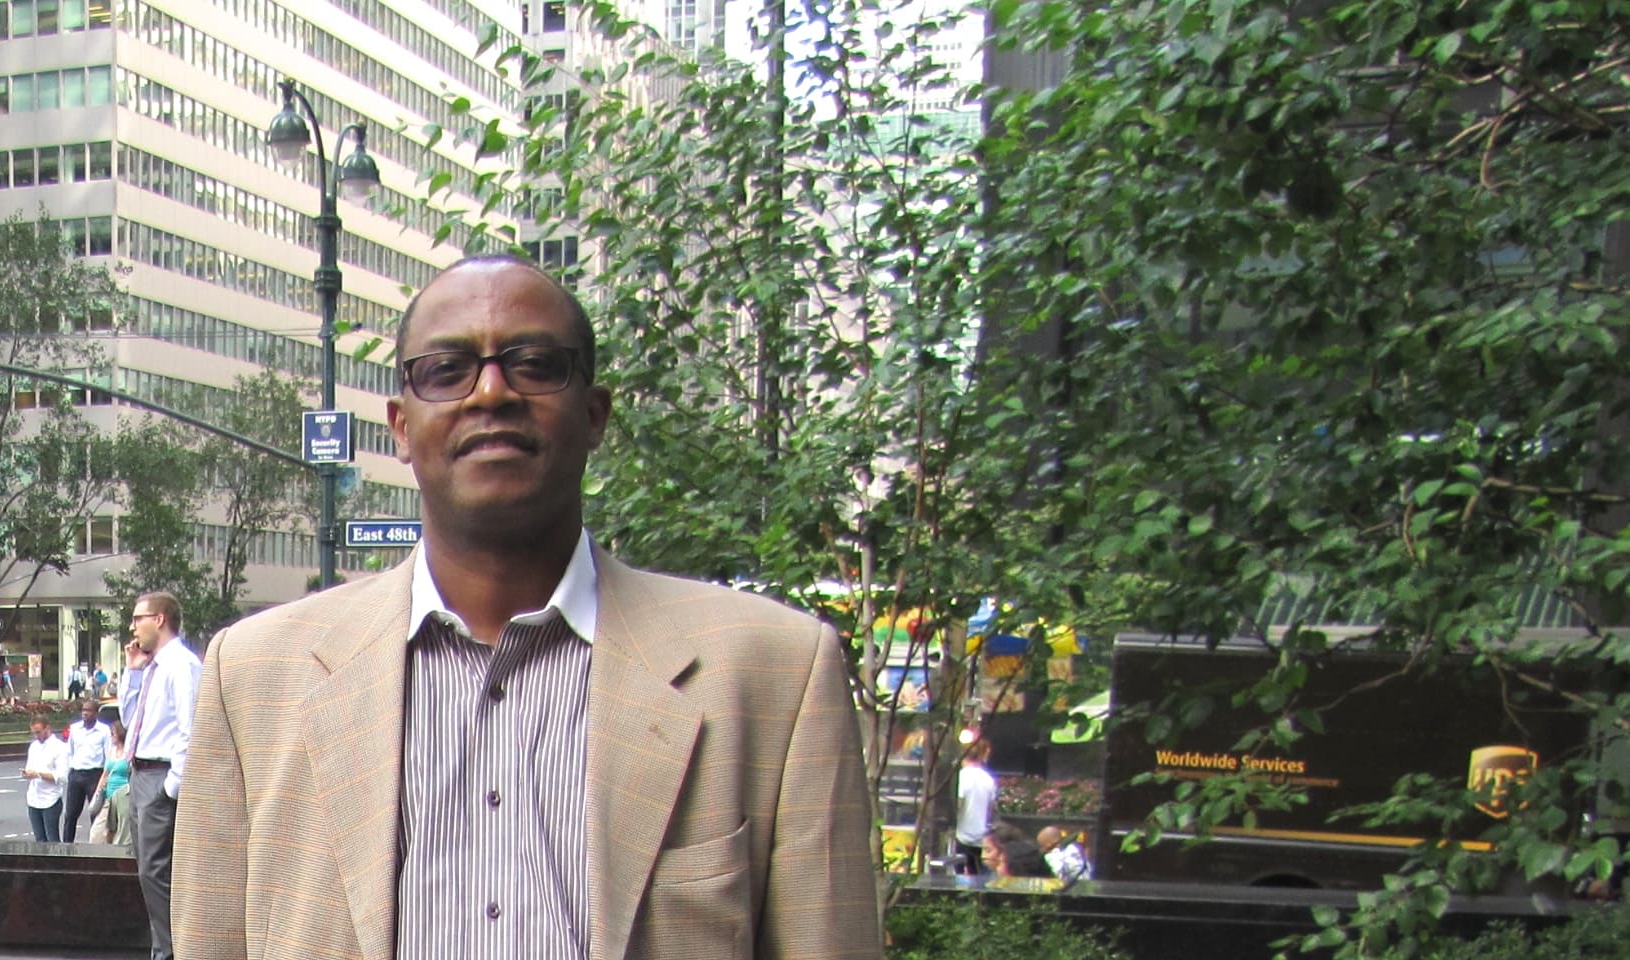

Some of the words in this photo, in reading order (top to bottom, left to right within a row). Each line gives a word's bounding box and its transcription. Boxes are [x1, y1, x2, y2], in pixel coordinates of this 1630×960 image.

[314, 415, 337, 424] NYPD
[311, 438, 341, 448] Security
[311, 447, 340, 455] Camera
[352, 527, 384, 542] East
[386, 527, 417, 542] 48th
[1155, 750, 1237, 770] Worldwide
[1240, 754, 1305, 773] Services
